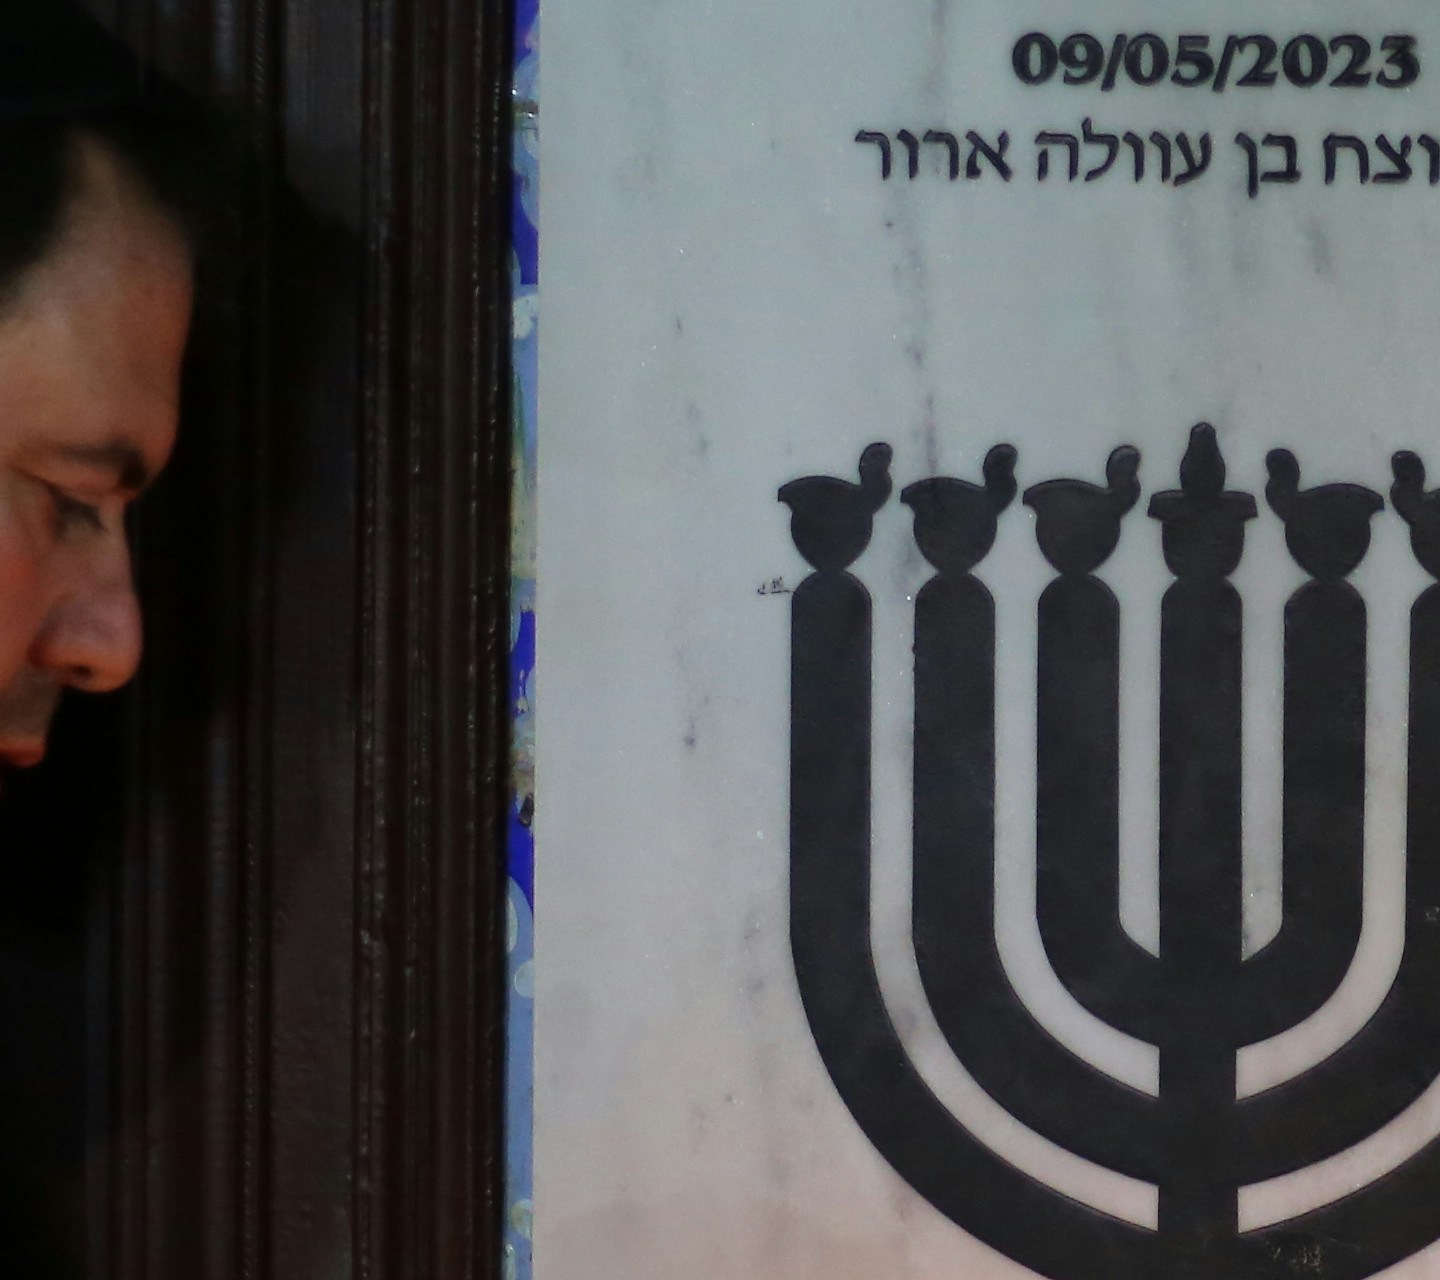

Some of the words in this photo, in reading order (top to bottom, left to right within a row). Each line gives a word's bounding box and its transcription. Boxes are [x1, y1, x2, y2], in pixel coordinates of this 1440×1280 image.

[1010, 30, 1422, 94] 09/05/2023
[853, 127, 1014, 183] ארור
[1033, 118, 1213, 188] עוולה
[1233, 130, 1303, 201] בן
